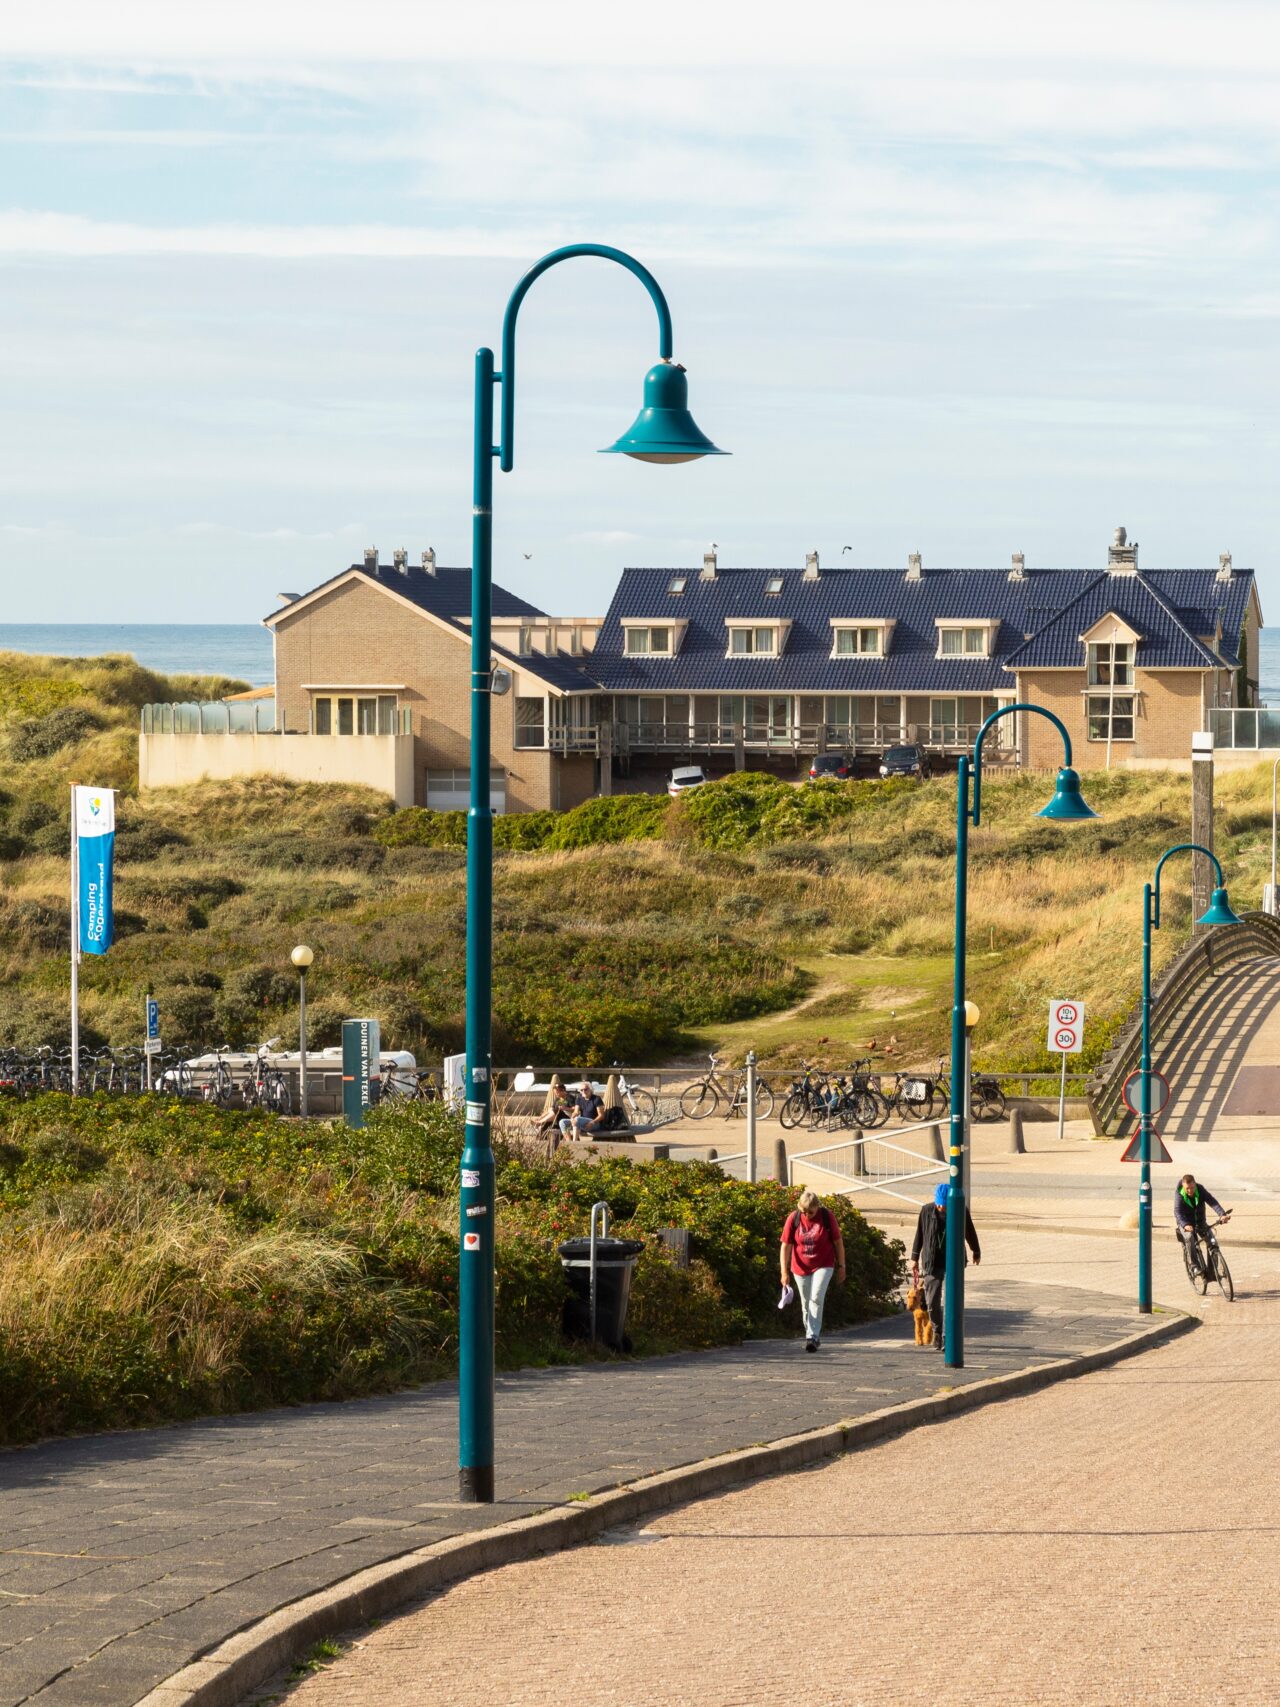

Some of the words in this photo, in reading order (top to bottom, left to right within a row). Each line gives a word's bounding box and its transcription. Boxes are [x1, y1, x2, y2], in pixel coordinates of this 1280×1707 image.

[88, 883, 97, 940] Camping
[94, 863, 104, 941] Kogerstrand
[150, 1004, 156, 1022] P
[360, 1022, 368, 1058] DUINEN
[1058, 1034, 1073, 1043] 30t
